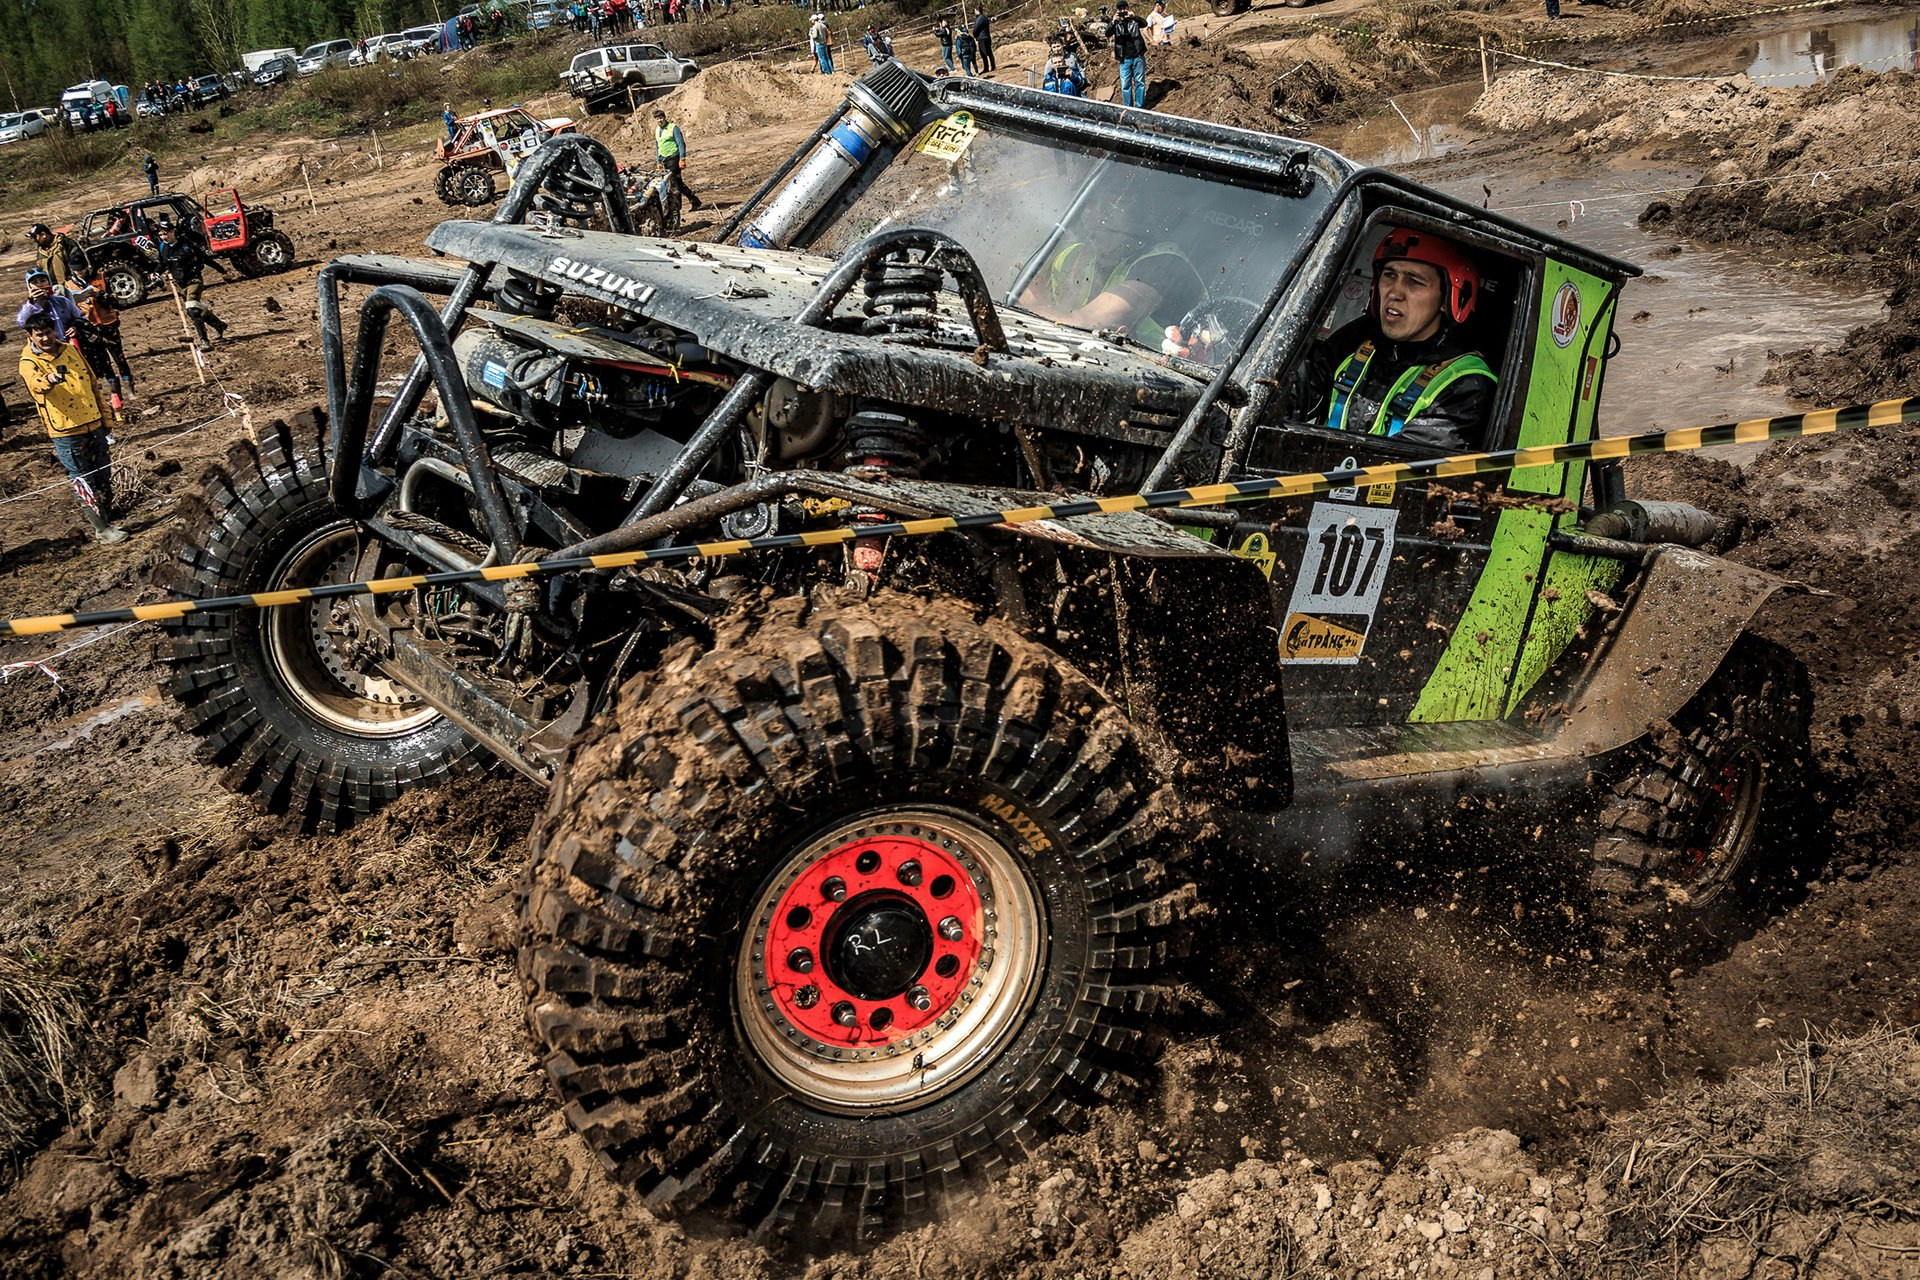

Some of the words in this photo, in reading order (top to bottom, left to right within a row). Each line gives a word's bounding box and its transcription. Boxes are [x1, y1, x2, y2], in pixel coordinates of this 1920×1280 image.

[1204, 211, 1264, 237] RECARO
[548, 256, 656, 303] SUZUKI
[1312, 523, 1385, 597] 107
[978, 793, 1053, 852] MAXXIS
